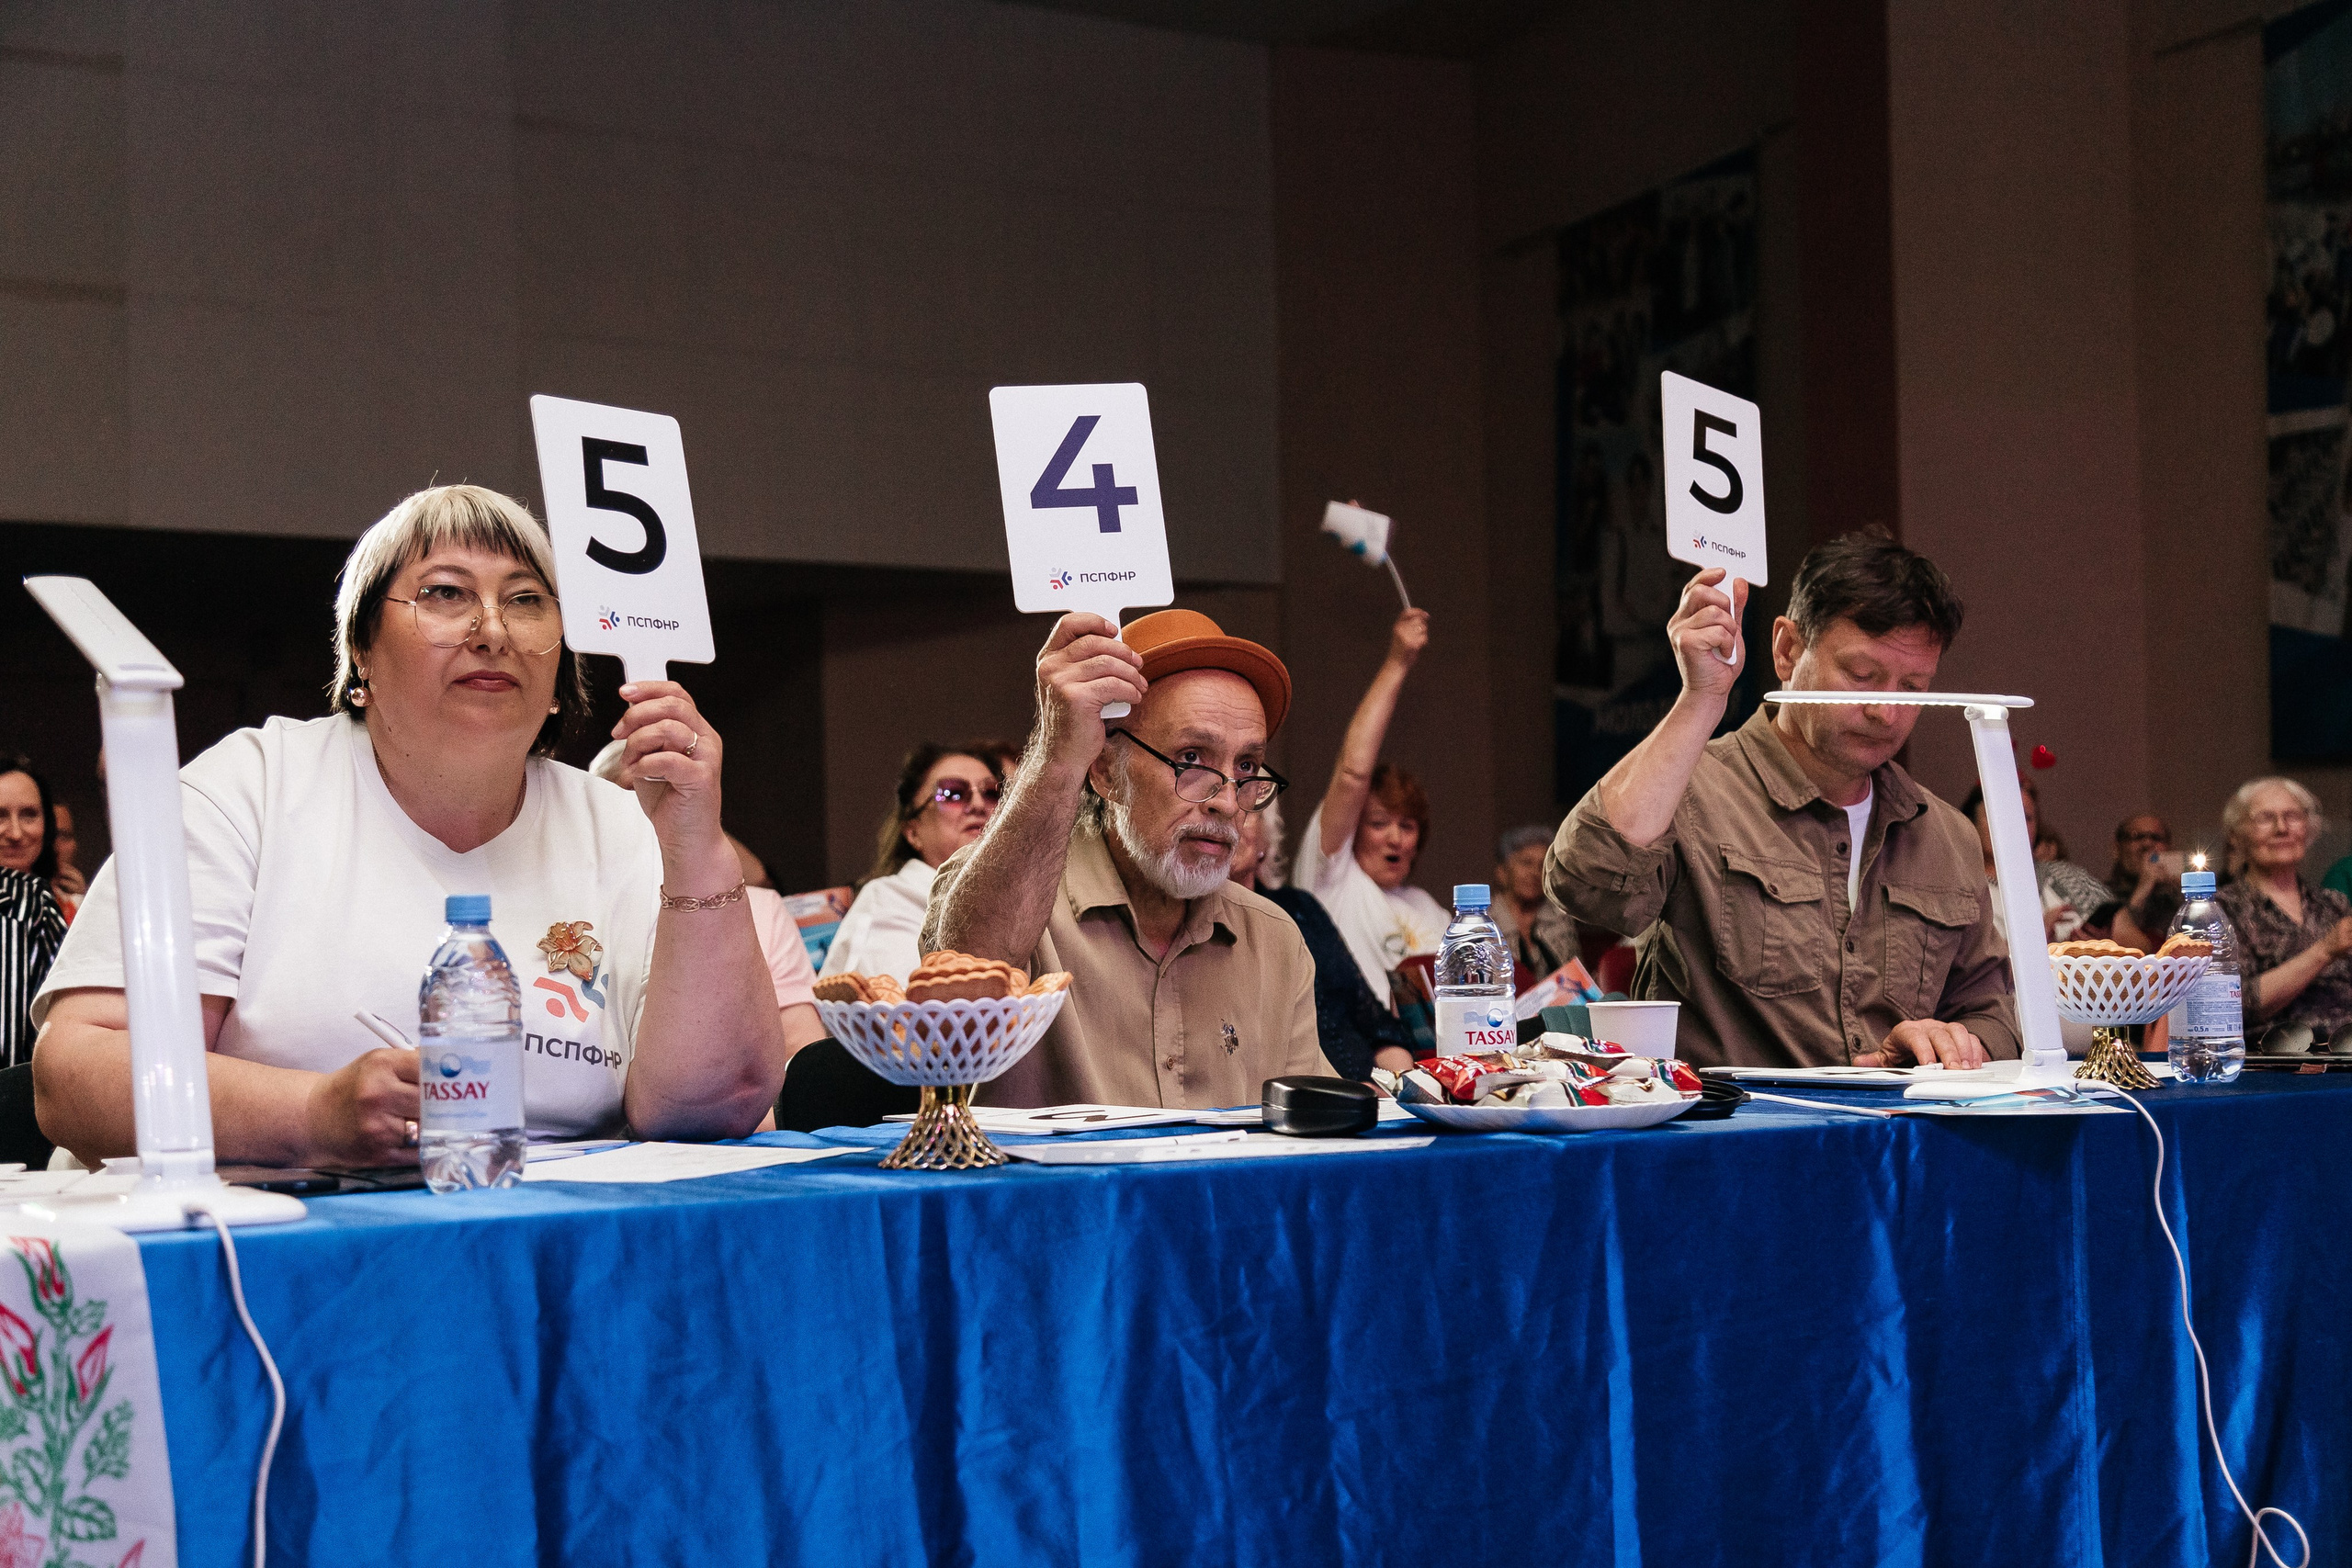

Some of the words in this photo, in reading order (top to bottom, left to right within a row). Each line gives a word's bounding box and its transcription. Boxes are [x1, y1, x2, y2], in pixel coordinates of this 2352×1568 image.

[1690, 409, 1744, 514] 5
[1030, 415, 1138, 534] 4
[582, 436, 667, 575] 5
[1712, 541, 1747, 559] ПСПФНР
[1080, 570, 1136, 583] ПСПФНР
[627, 615, 680, 631] ПСПФНР
[1464, 1029, 1516, 1045] TASSAY
[525, 1032, 622, 1070] ПСПФНР
[423, 1080, 490, 1101] TASSAY
